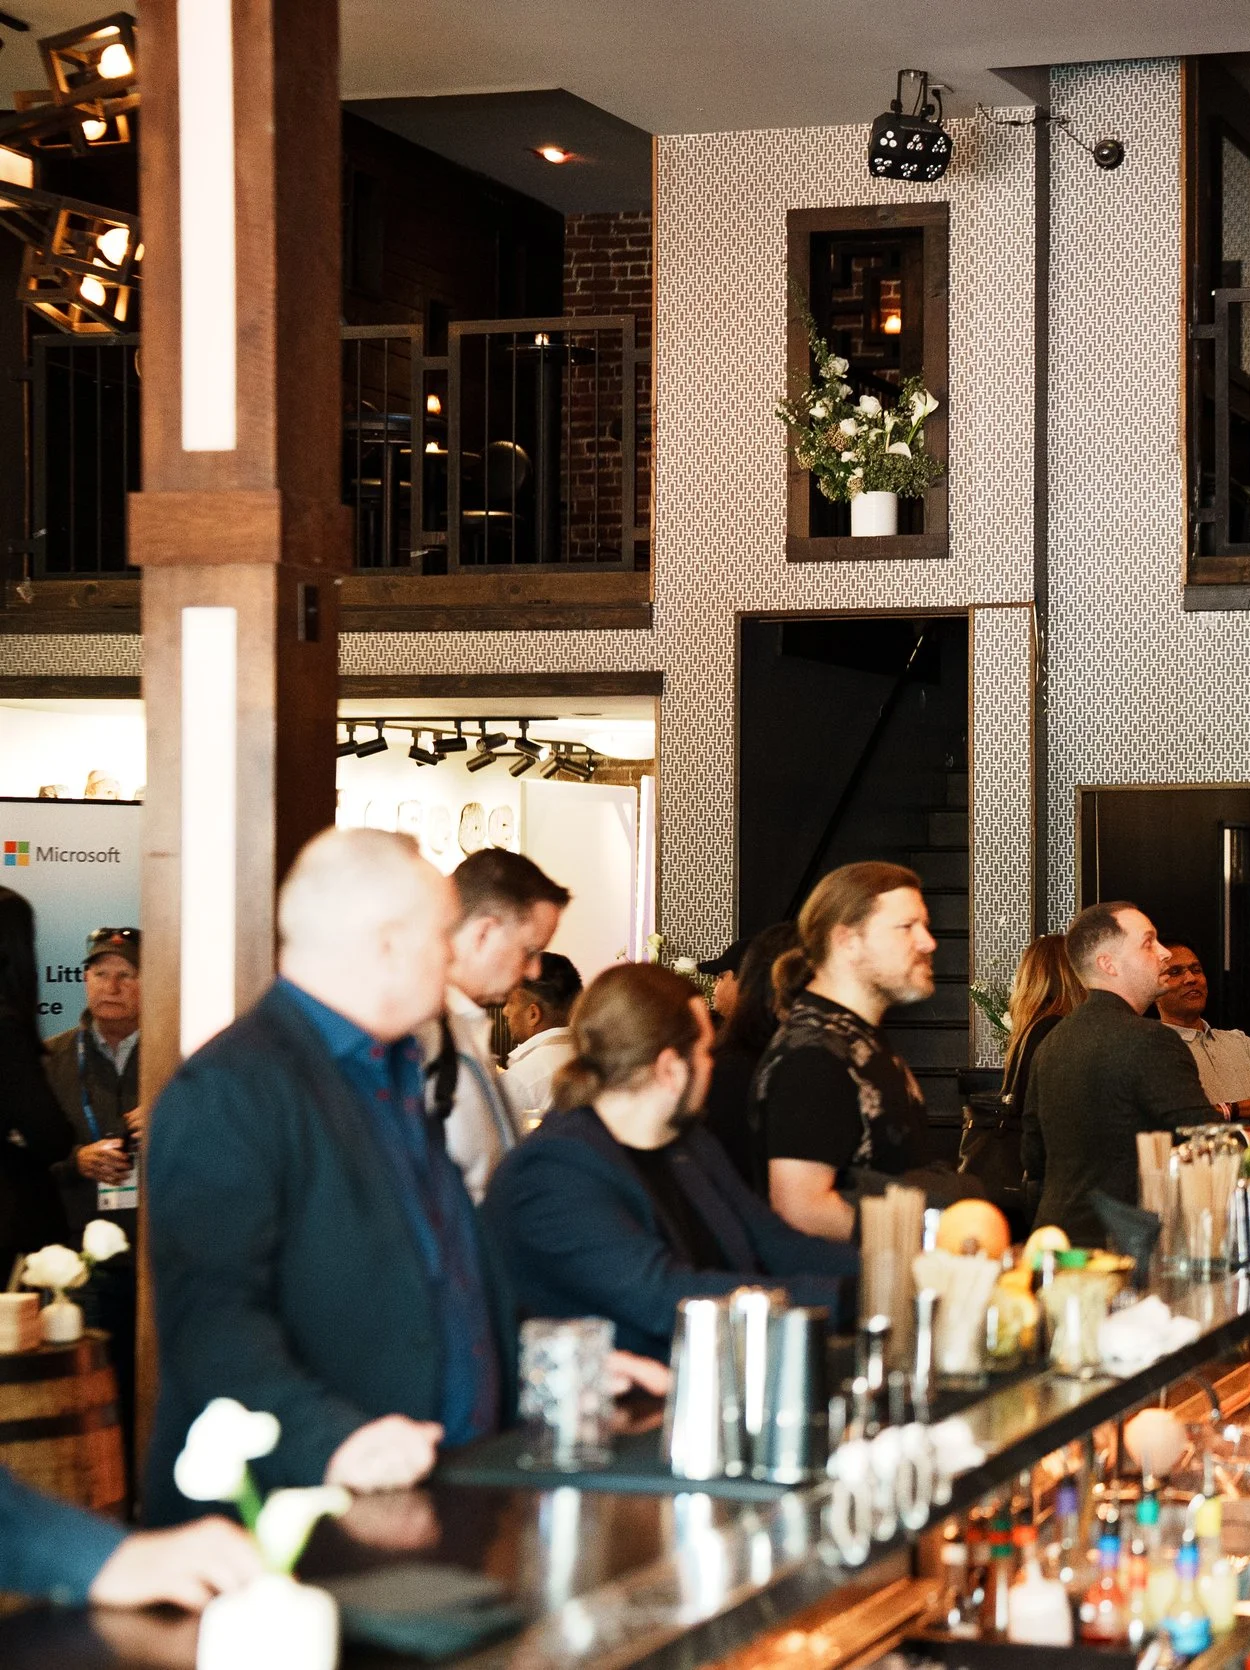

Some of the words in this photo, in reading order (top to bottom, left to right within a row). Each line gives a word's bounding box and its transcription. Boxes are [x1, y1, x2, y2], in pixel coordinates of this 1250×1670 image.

[35, 846, 121, 863] Microsoft
[46, 965, 89, 983] Litt
[37, 1002, 63, 1015] ce
